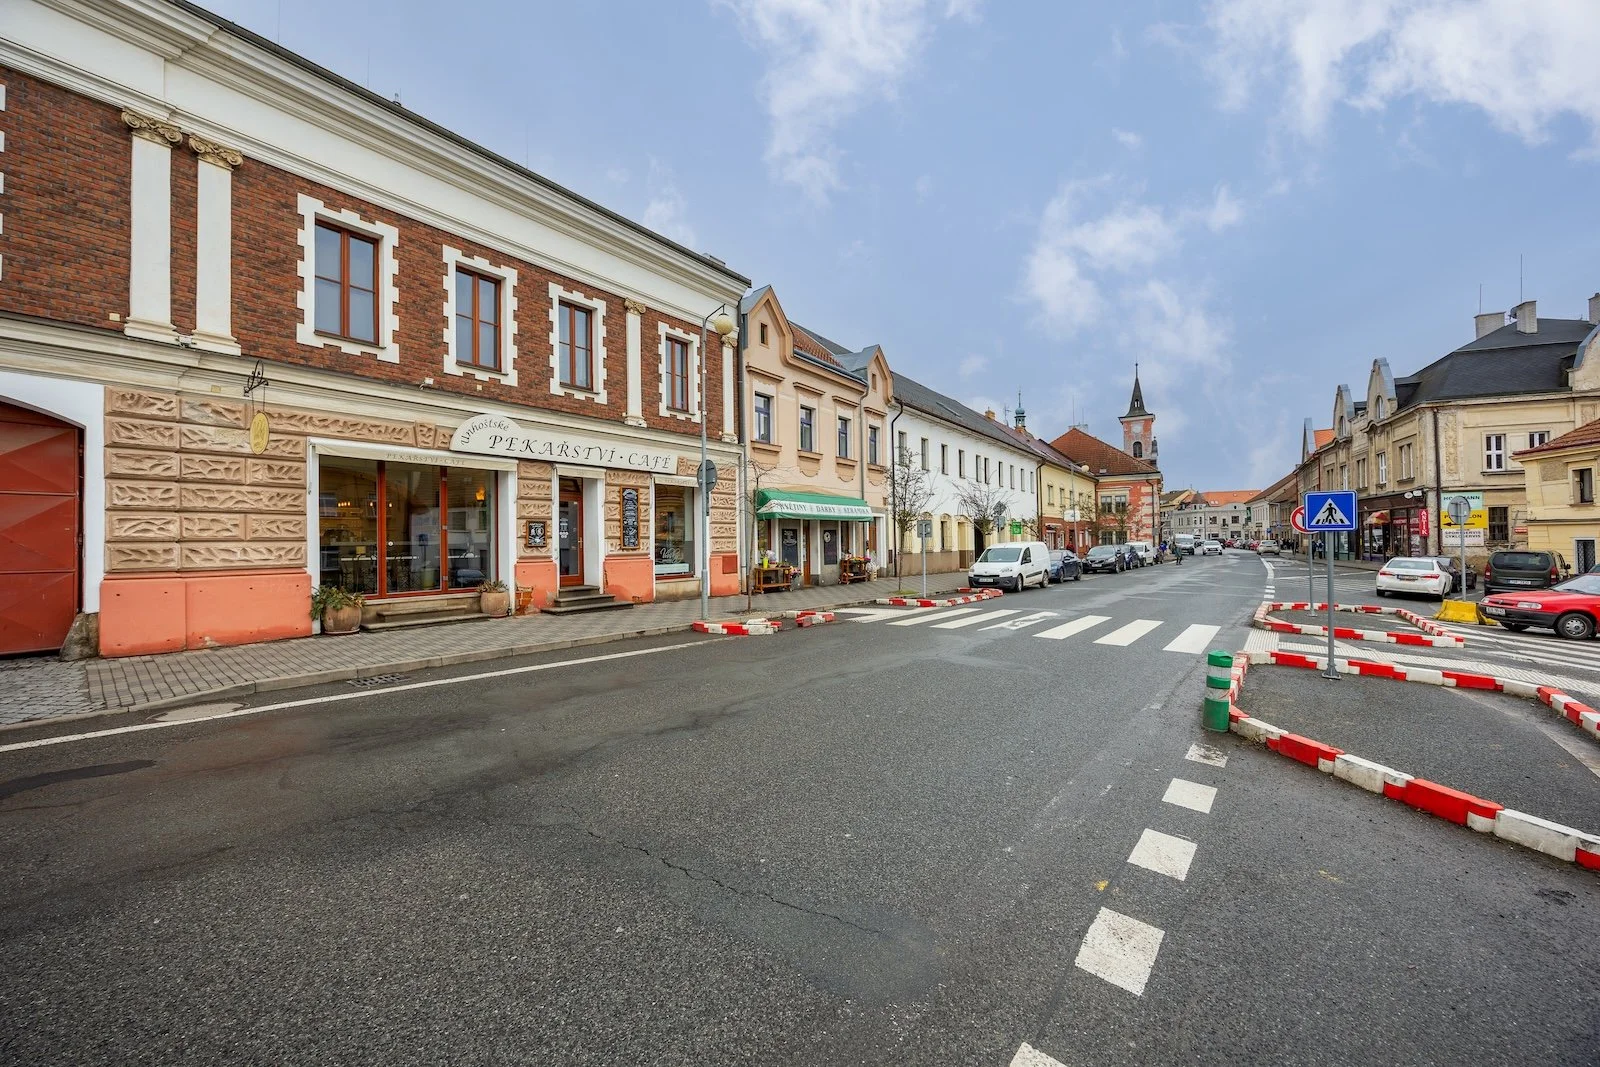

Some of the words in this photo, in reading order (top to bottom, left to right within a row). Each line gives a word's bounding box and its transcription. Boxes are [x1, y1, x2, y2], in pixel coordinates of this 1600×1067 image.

[489, 434, 616, 463] PEKAŘSTVÍ
[628, 453, 671, 470] CAFÉ
[1420, 510, 1428, 535] ANTIK
